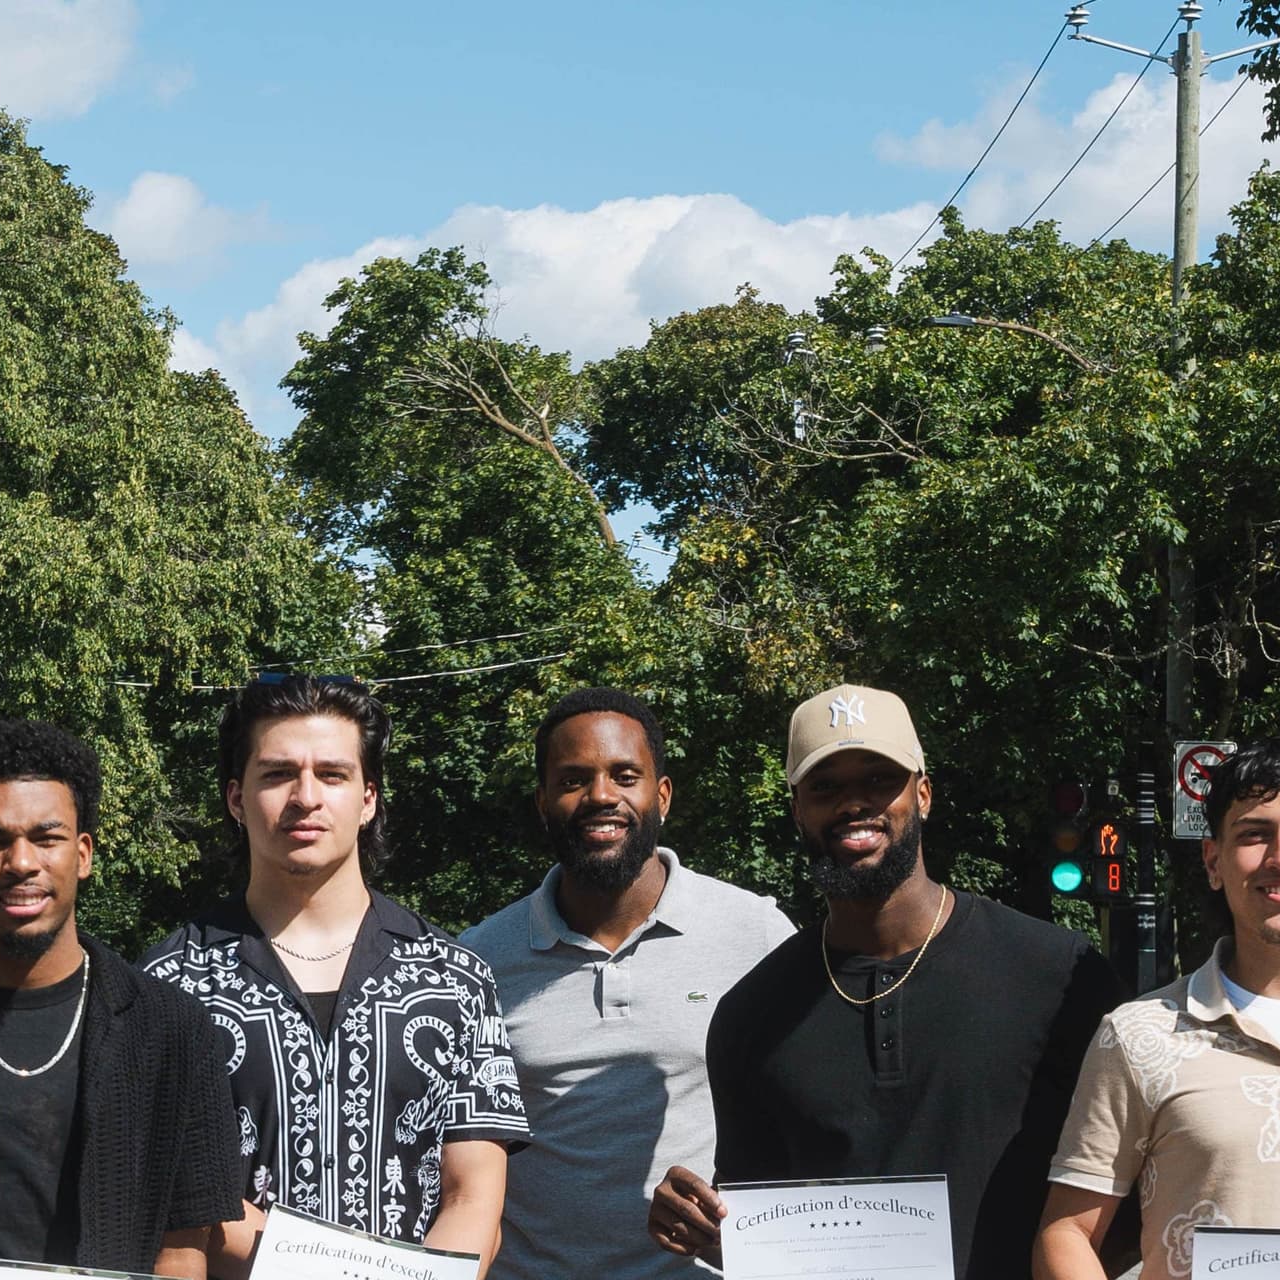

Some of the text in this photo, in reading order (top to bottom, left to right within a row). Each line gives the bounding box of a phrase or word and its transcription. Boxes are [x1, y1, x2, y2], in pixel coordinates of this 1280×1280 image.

[828, 693, 866, 728] NY
[1109, 863, 1120, 891] 8
[454, 951, 470, 967] IS
[382, 1155, 406, 1238] 東京
[736, 1199, 834, 1231] Certification
[274, 1240, 372, 1265] Certification
